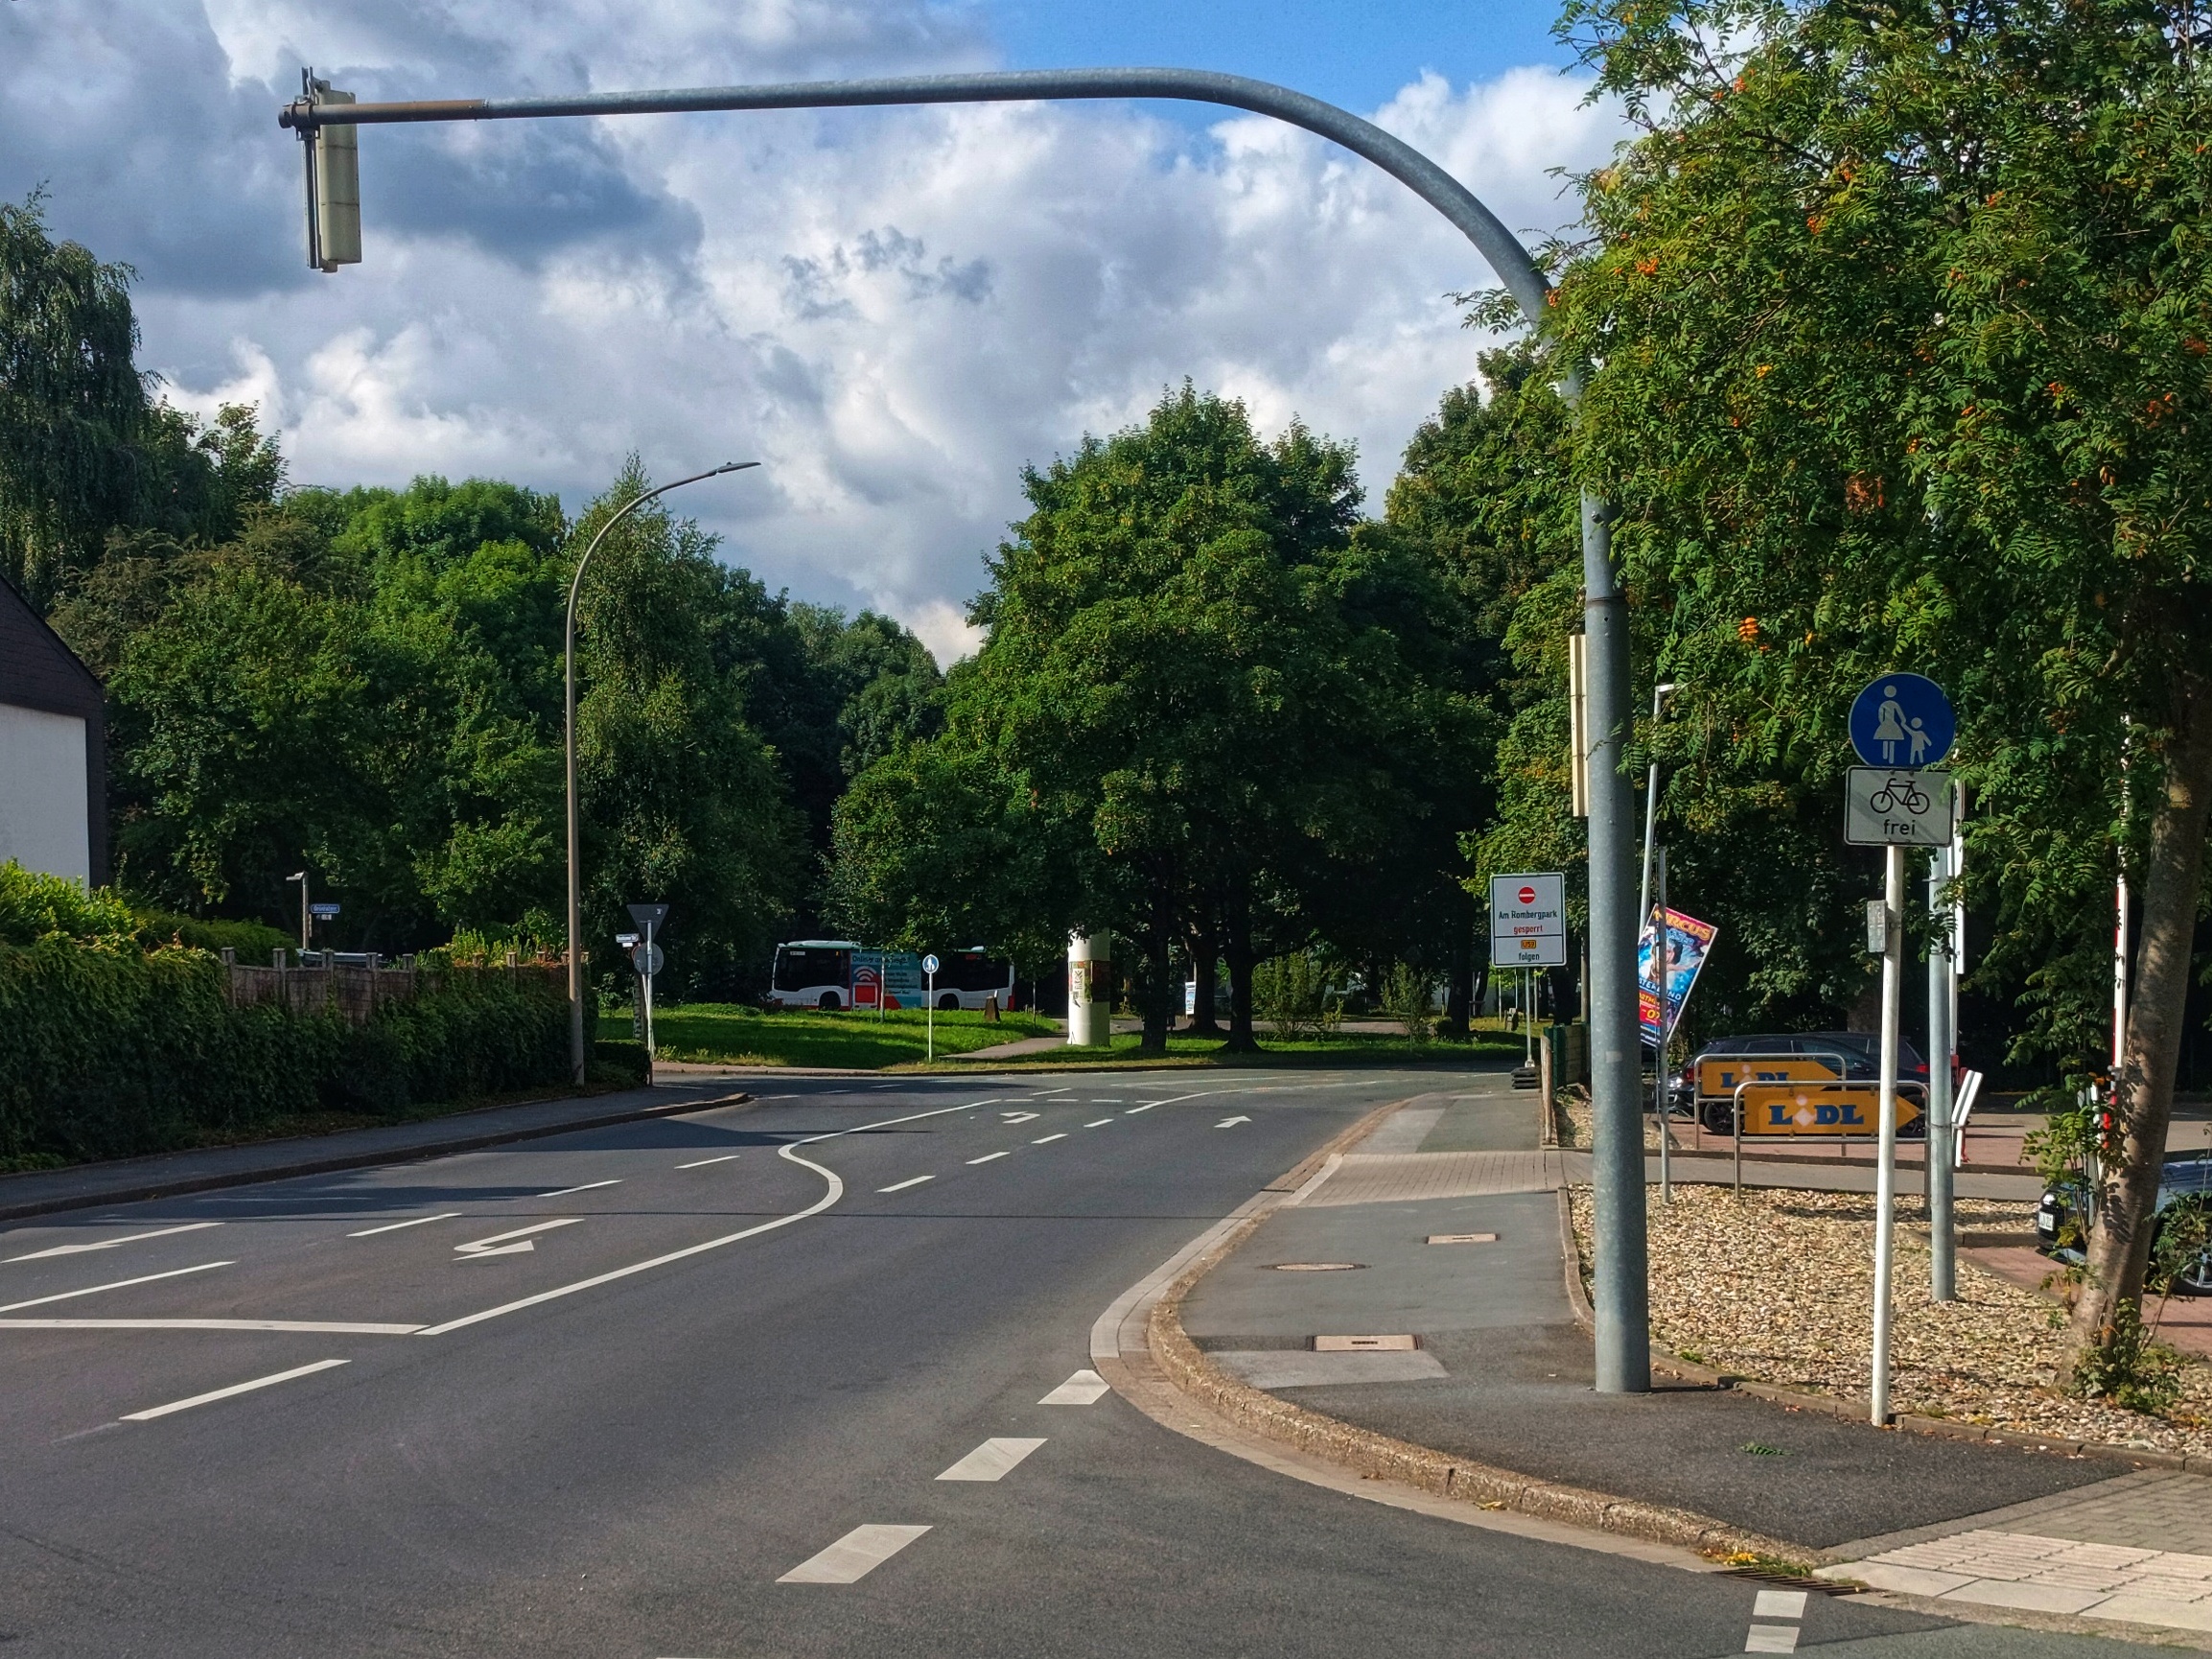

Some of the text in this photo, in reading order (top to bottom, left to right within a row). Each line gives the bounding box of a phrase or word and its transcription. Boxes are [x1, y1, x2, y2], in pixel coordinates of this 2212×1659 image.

[1883, 819, 1916, 835] frei
[1499, 909, 1558, 921] Am Rombergpark
[1513, 924, 1544, 935] gesperrt
[1518, 951, 1540, 962] folgen
[1768, 1094, 1864, 1127] LIDL
